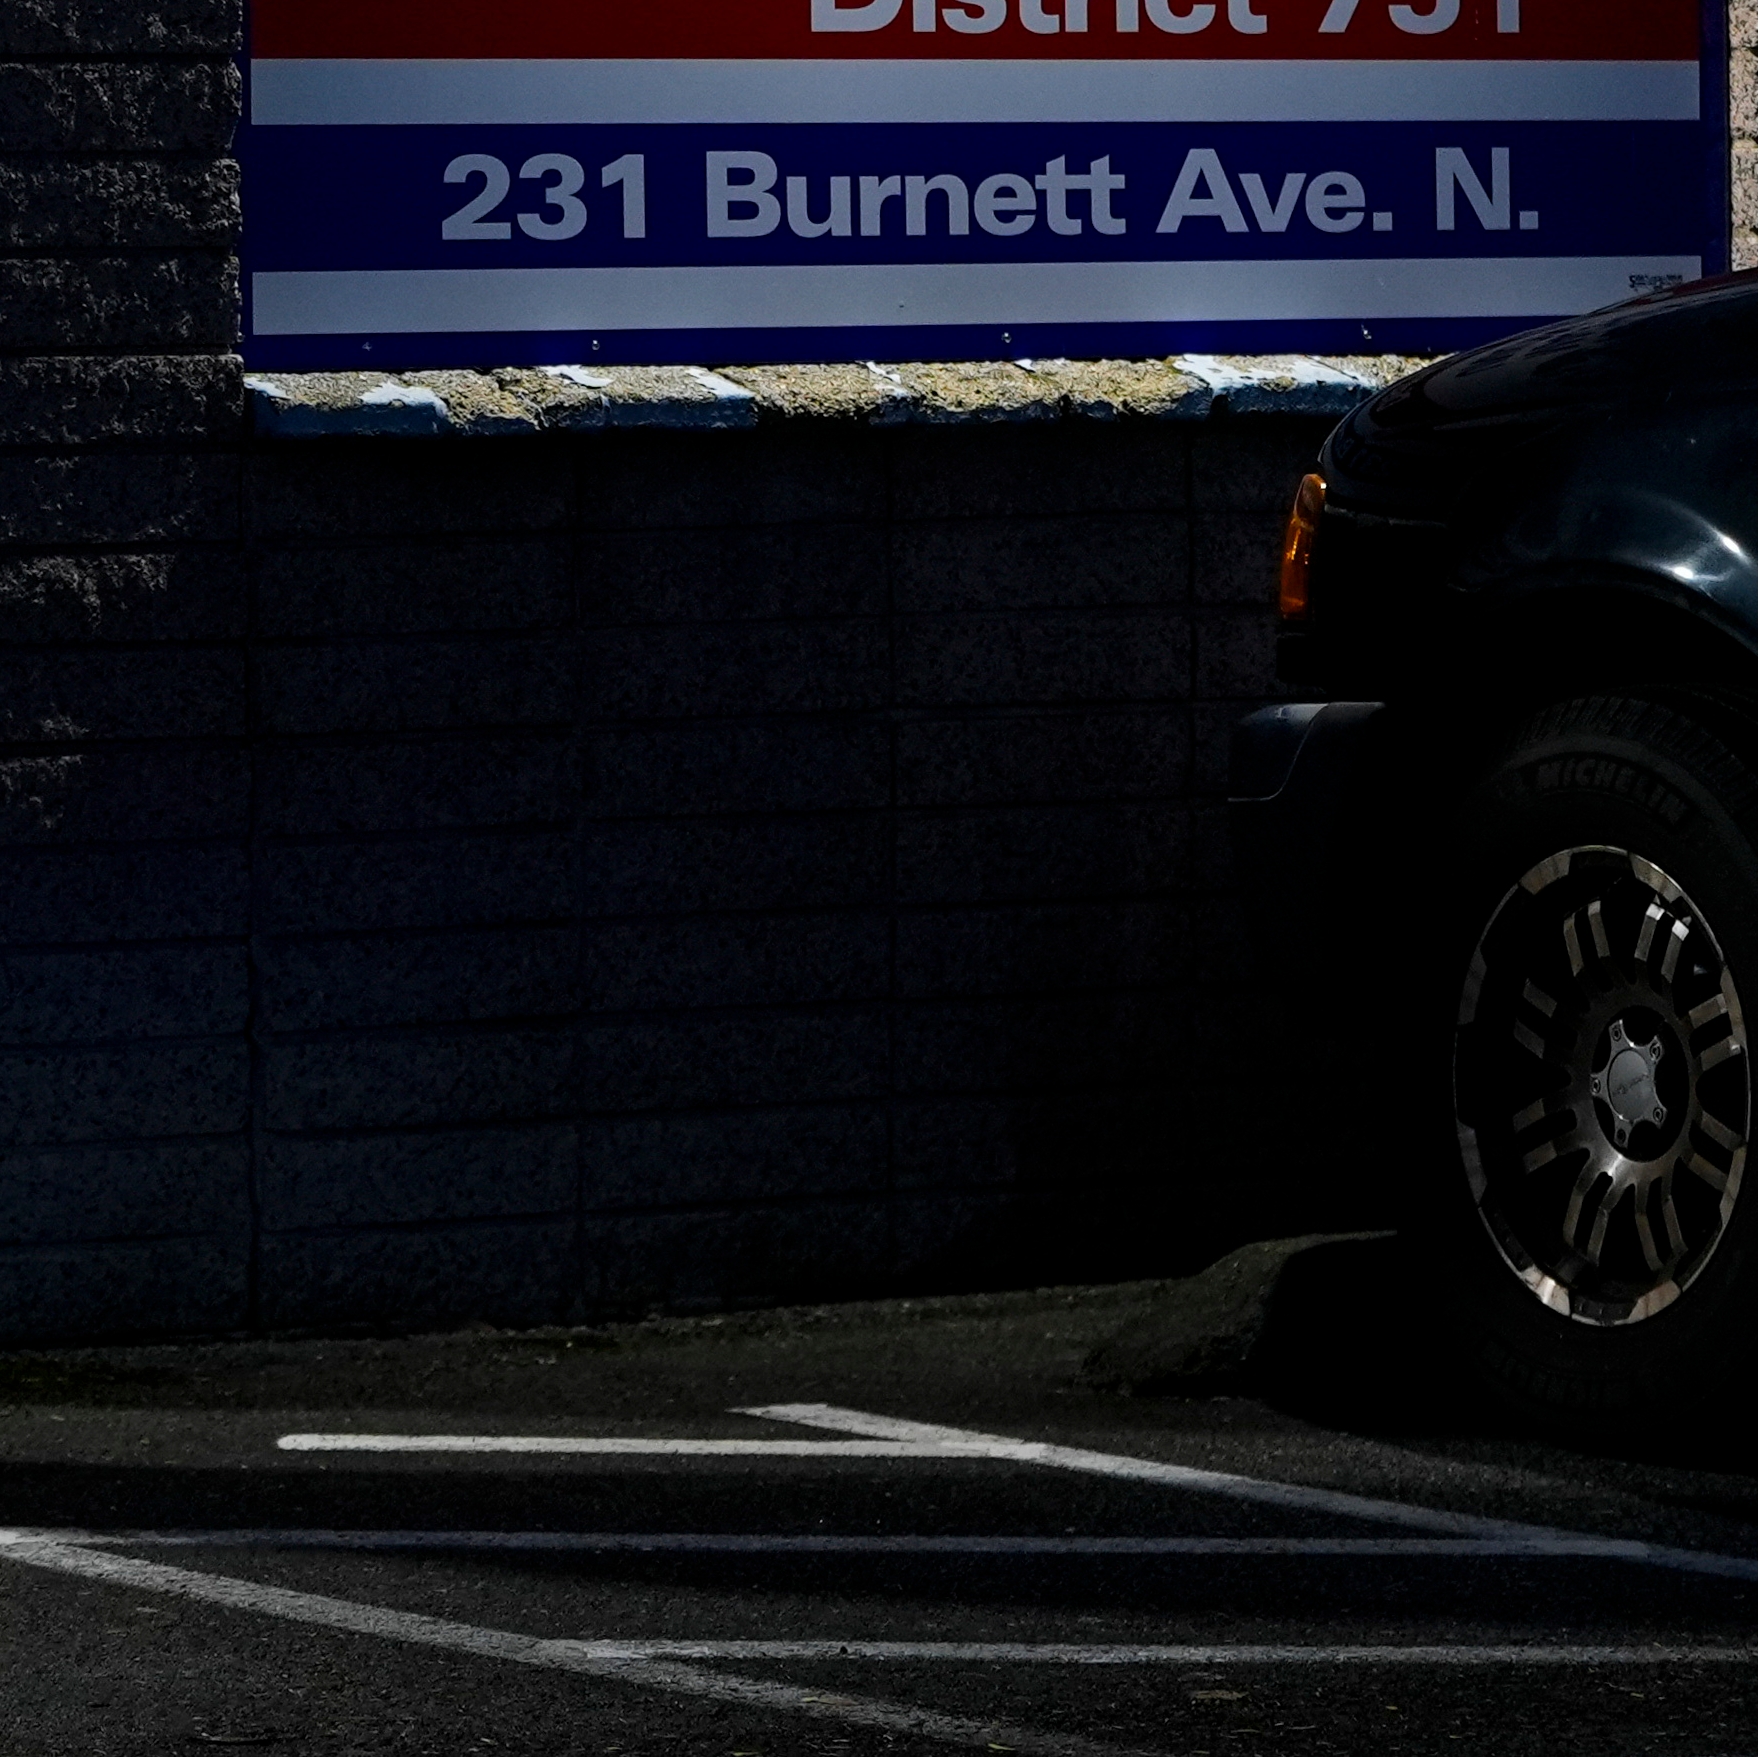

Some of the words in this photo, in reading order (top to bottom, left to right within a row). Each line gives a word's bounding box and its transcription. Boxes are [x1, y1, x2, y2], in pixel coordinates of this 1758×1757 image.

[441, 152, 647, 241] 231
[705, 149, 1127, 239] Burnett
[1154, 147, 1394, 234] Ave.
[1434, 146, 1540, 231] N.
[1534, 756, 1692, 828] MICHELIN
